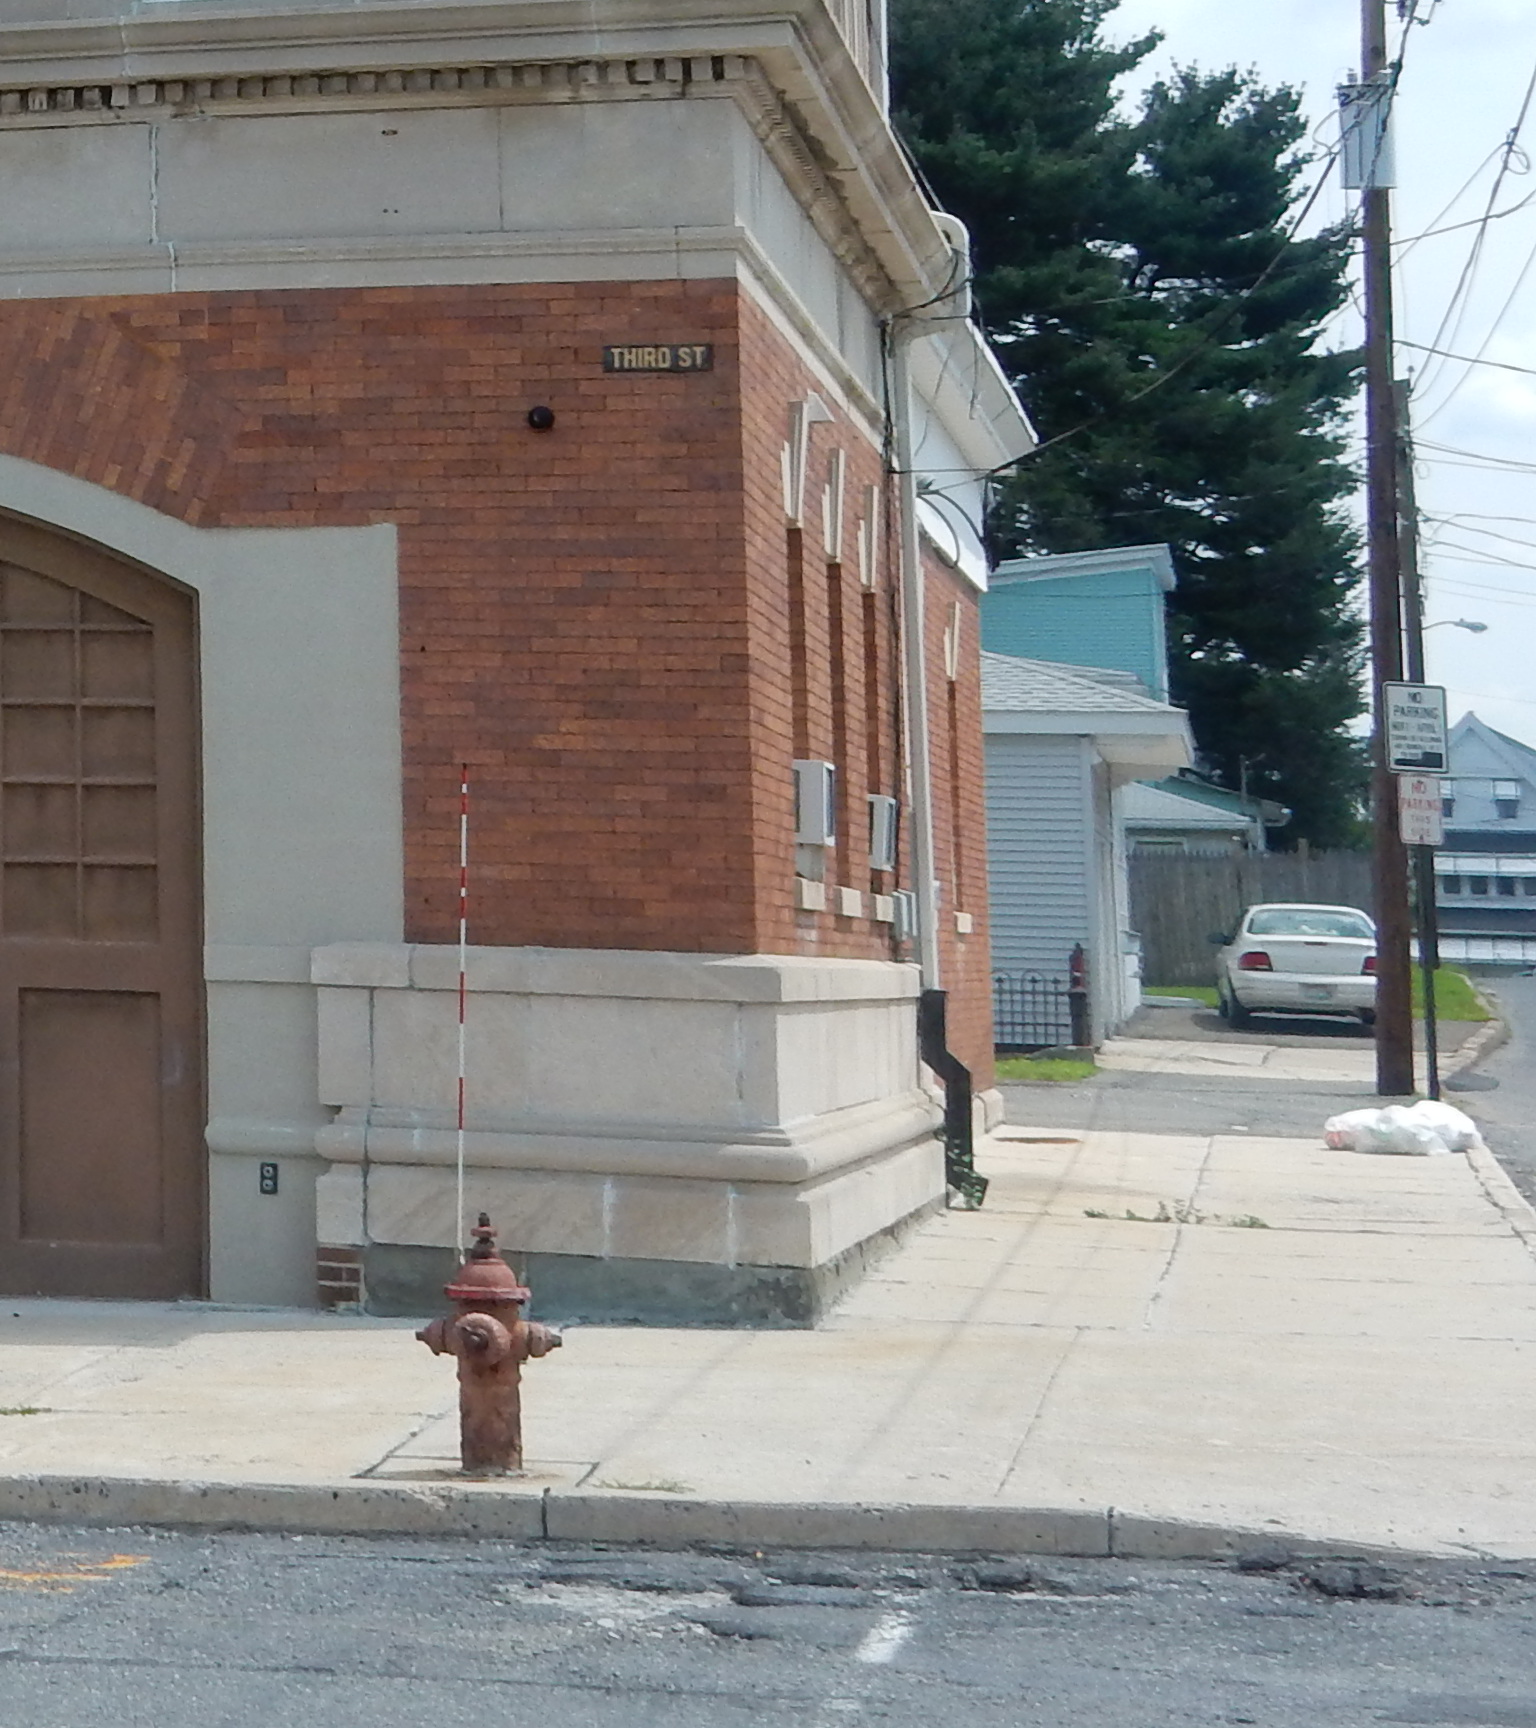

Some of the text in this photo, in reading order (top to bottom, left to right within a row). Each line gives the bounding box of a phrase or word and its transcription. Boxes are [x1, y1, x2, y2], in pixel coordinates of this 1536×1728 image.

[610, 346, 707, 369] THIRD ST
[1393, 704, 1440, 720] PARKING
